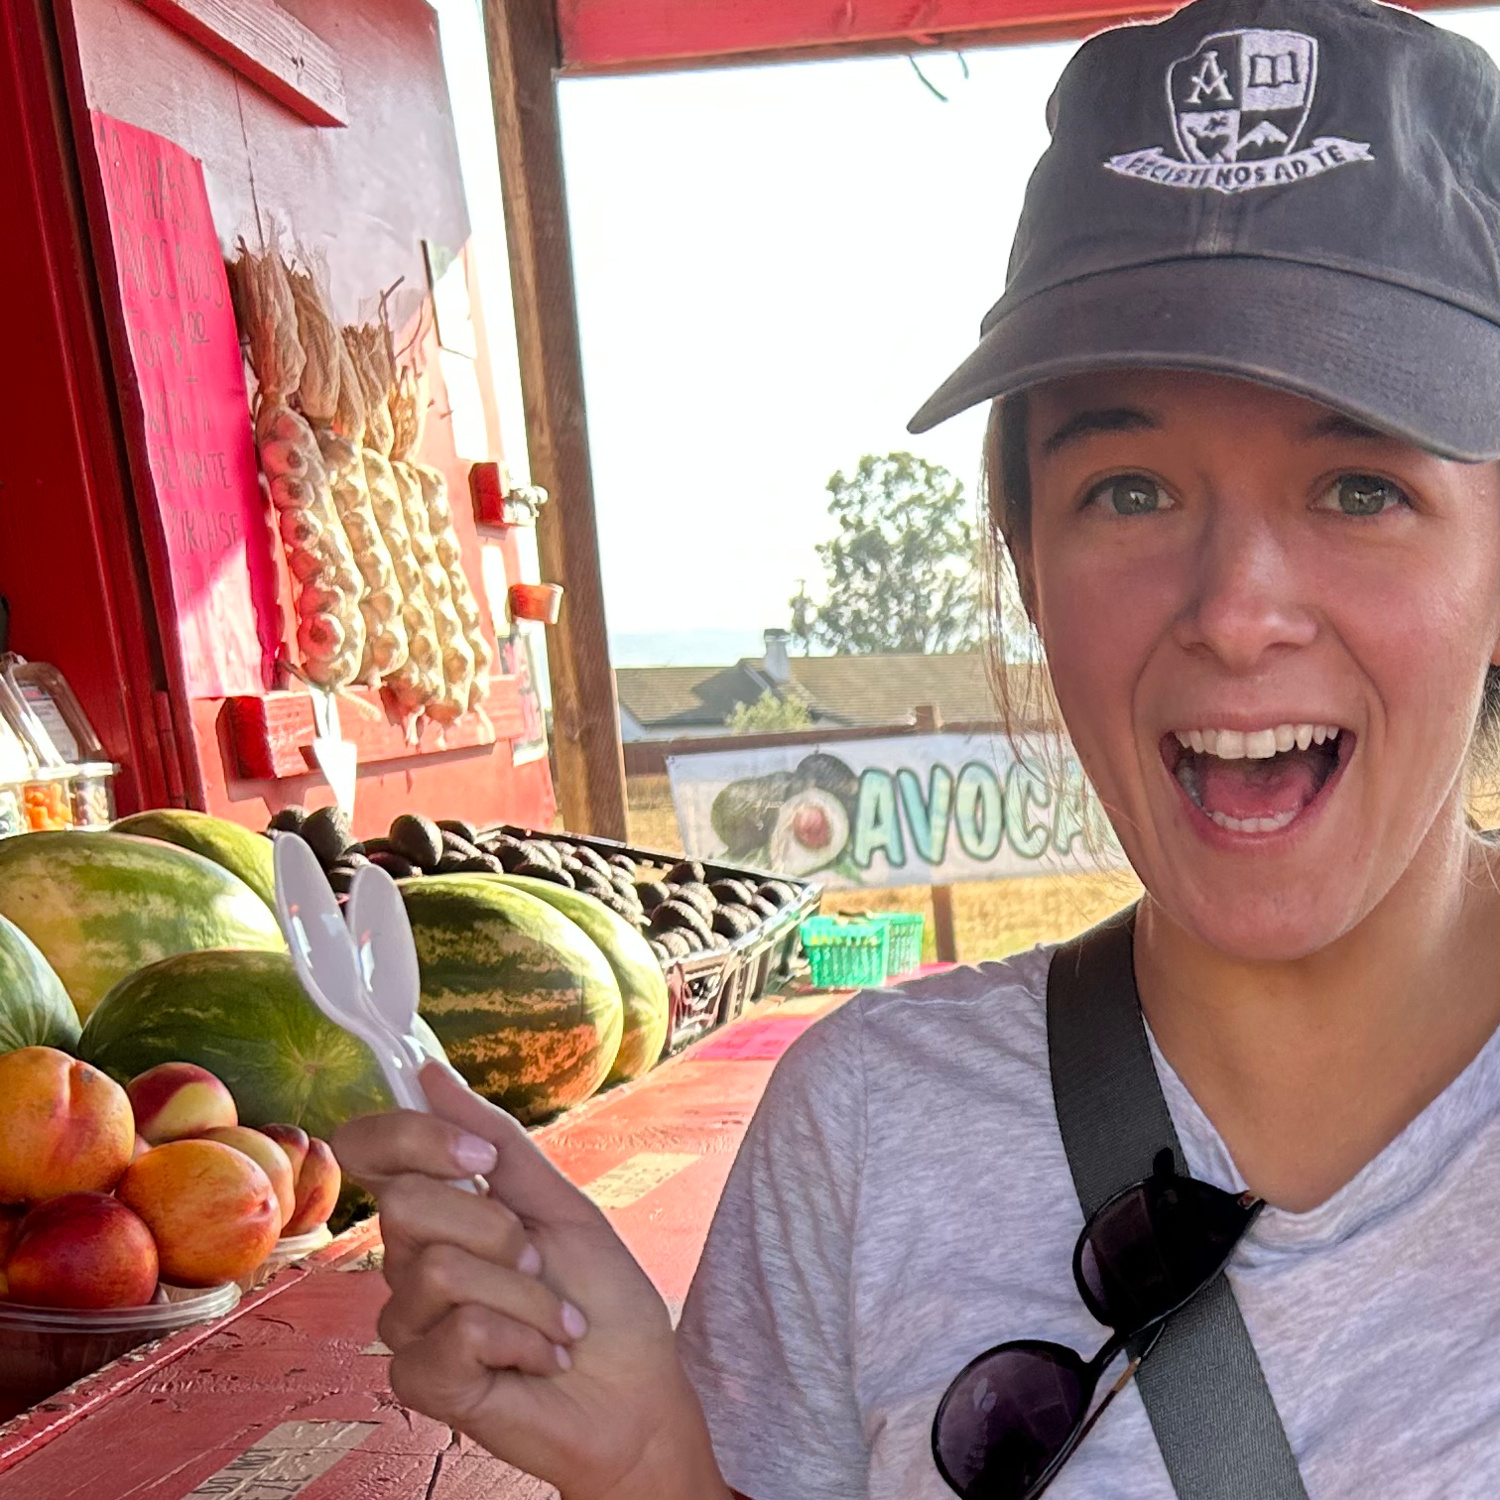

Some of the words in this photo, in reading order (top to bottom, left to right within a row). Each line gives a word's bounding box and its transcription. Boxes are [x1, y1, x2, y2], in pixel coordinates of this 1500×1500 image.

[1215, 164, 1266, 186] NOS
[1275, 161, 1308, 182] AD
[1309, 145, 1347, 168] TE
[852, 757, 1119, 868] AVOCA
[190, 1475, 245, 1494] DO
